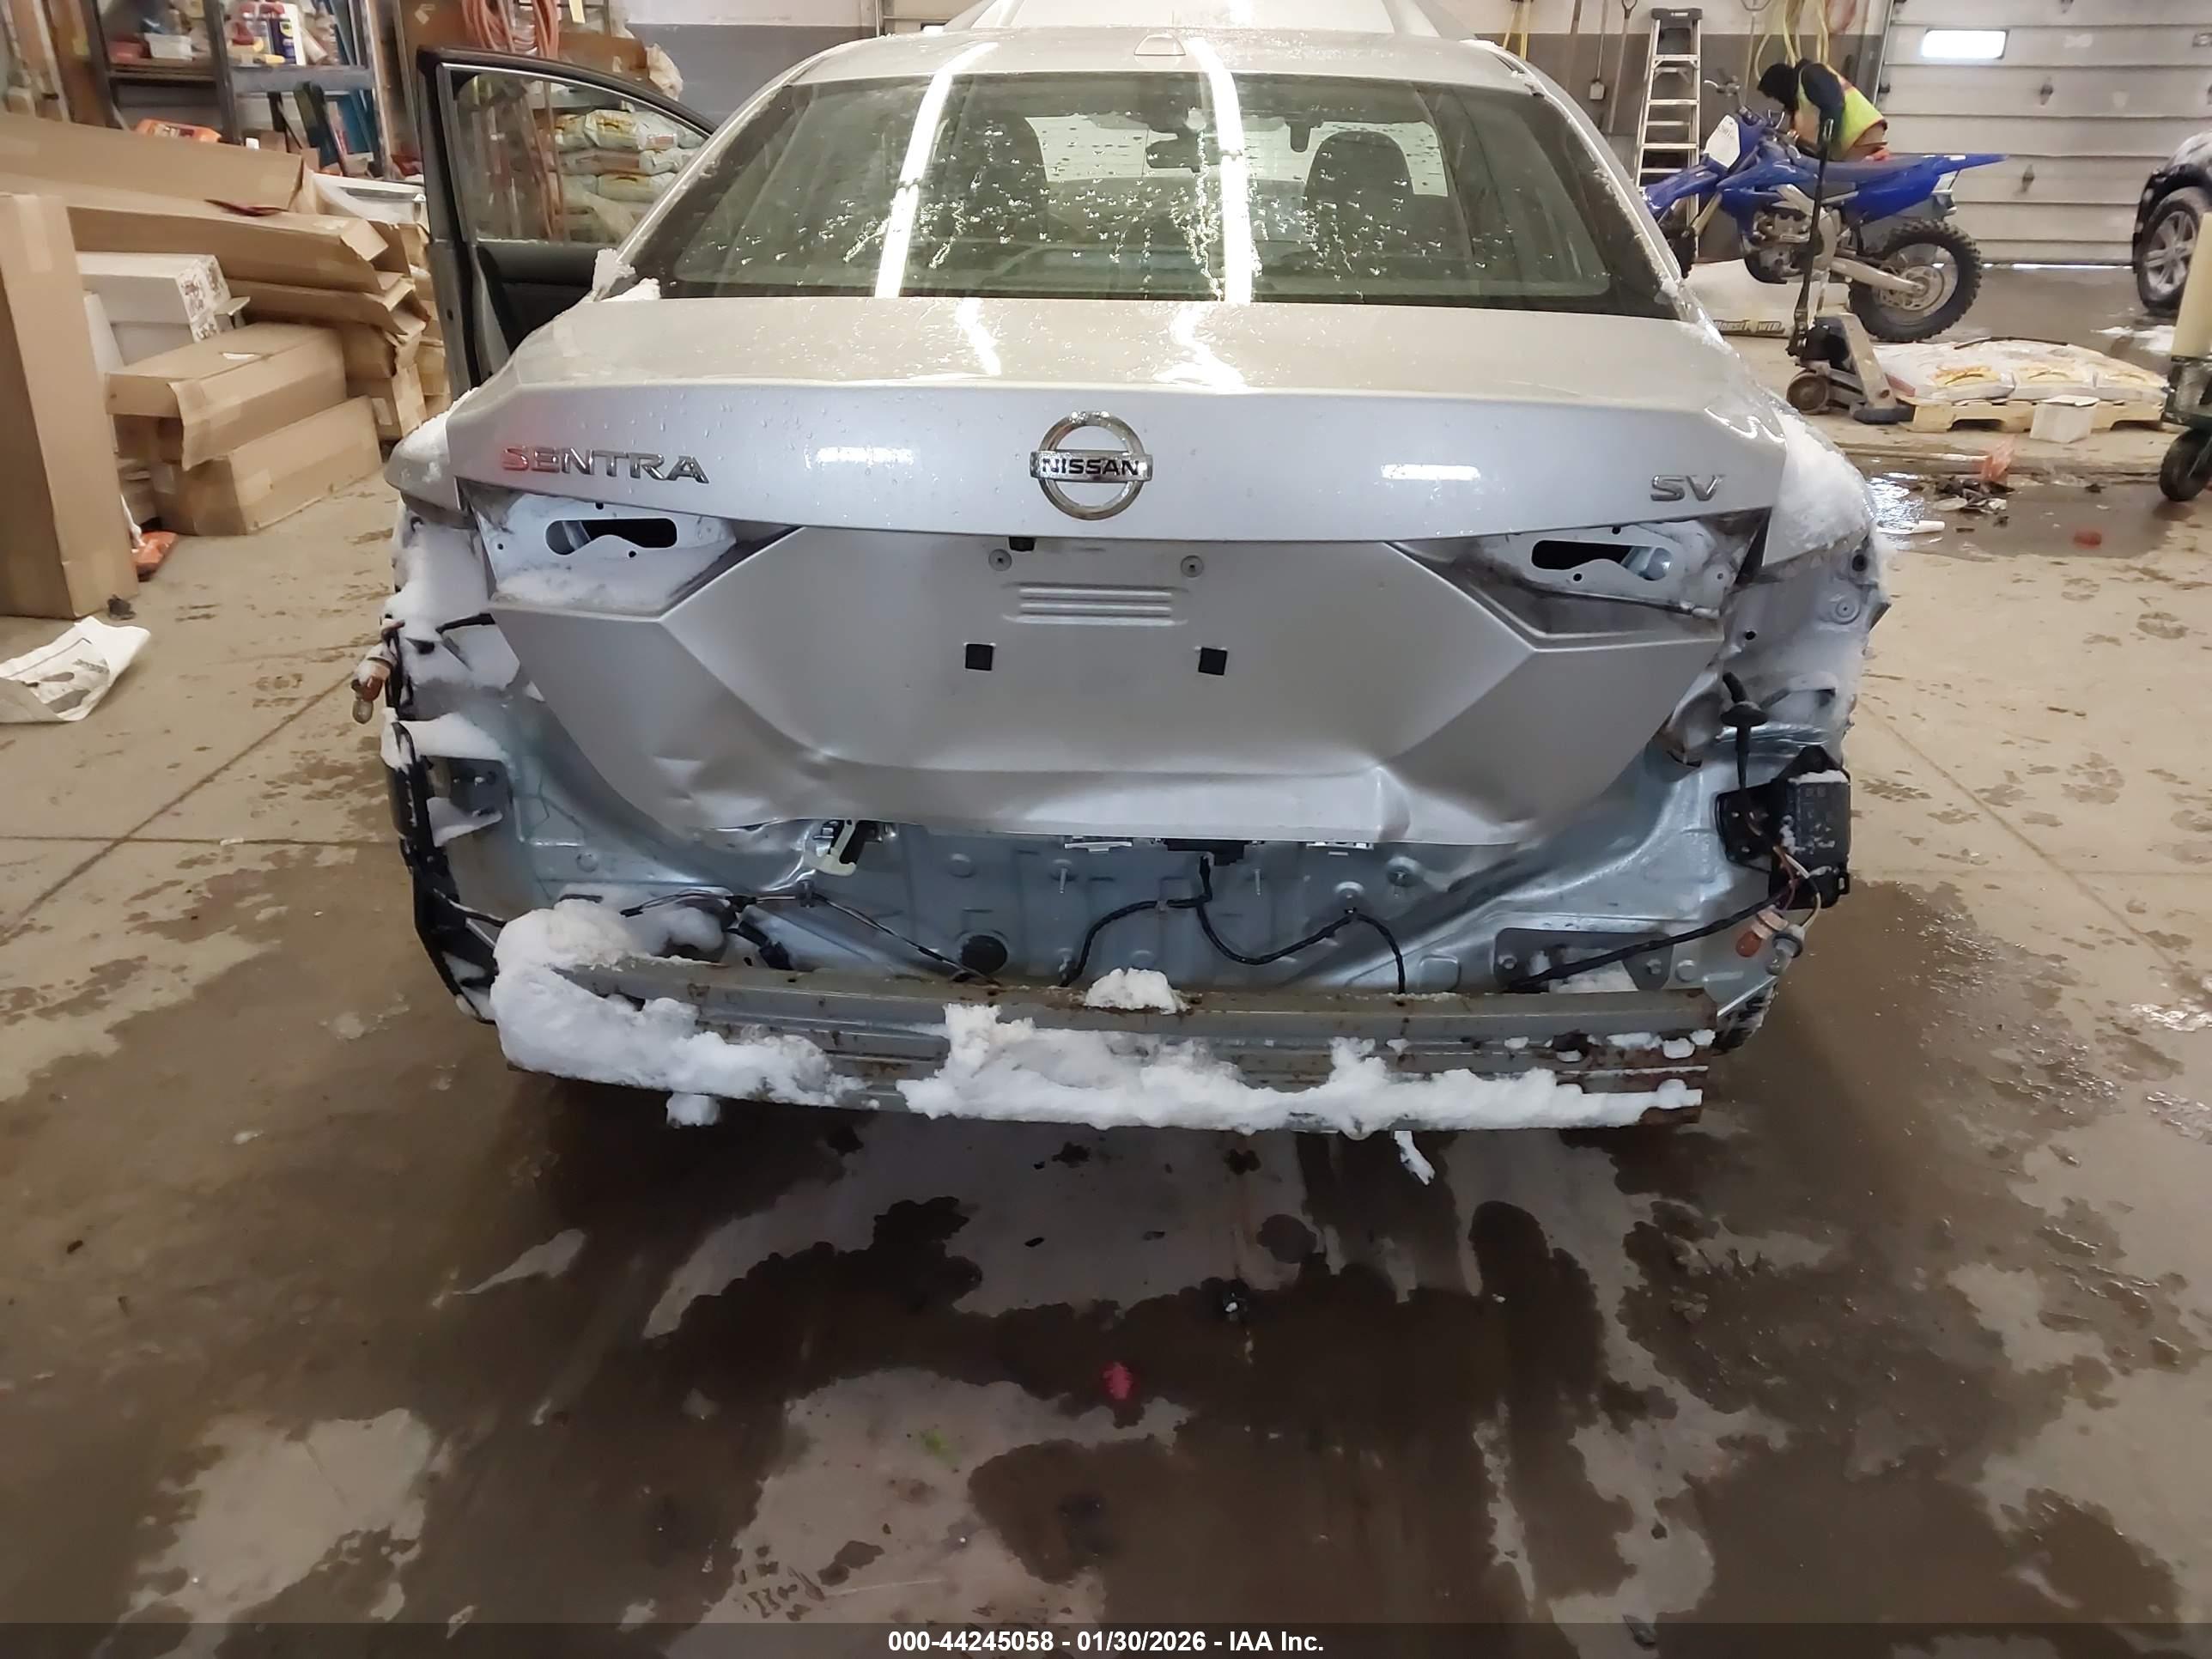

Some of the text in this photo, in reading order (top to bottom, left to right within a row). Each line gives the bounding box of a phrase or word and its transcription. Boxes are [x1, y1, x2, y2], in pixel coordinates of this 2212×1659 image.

[502, 447, 710, 484] SENTRA
[1041, 457, 1140, 476] NISSAN
[1650, 474, 1725, 501] SV
